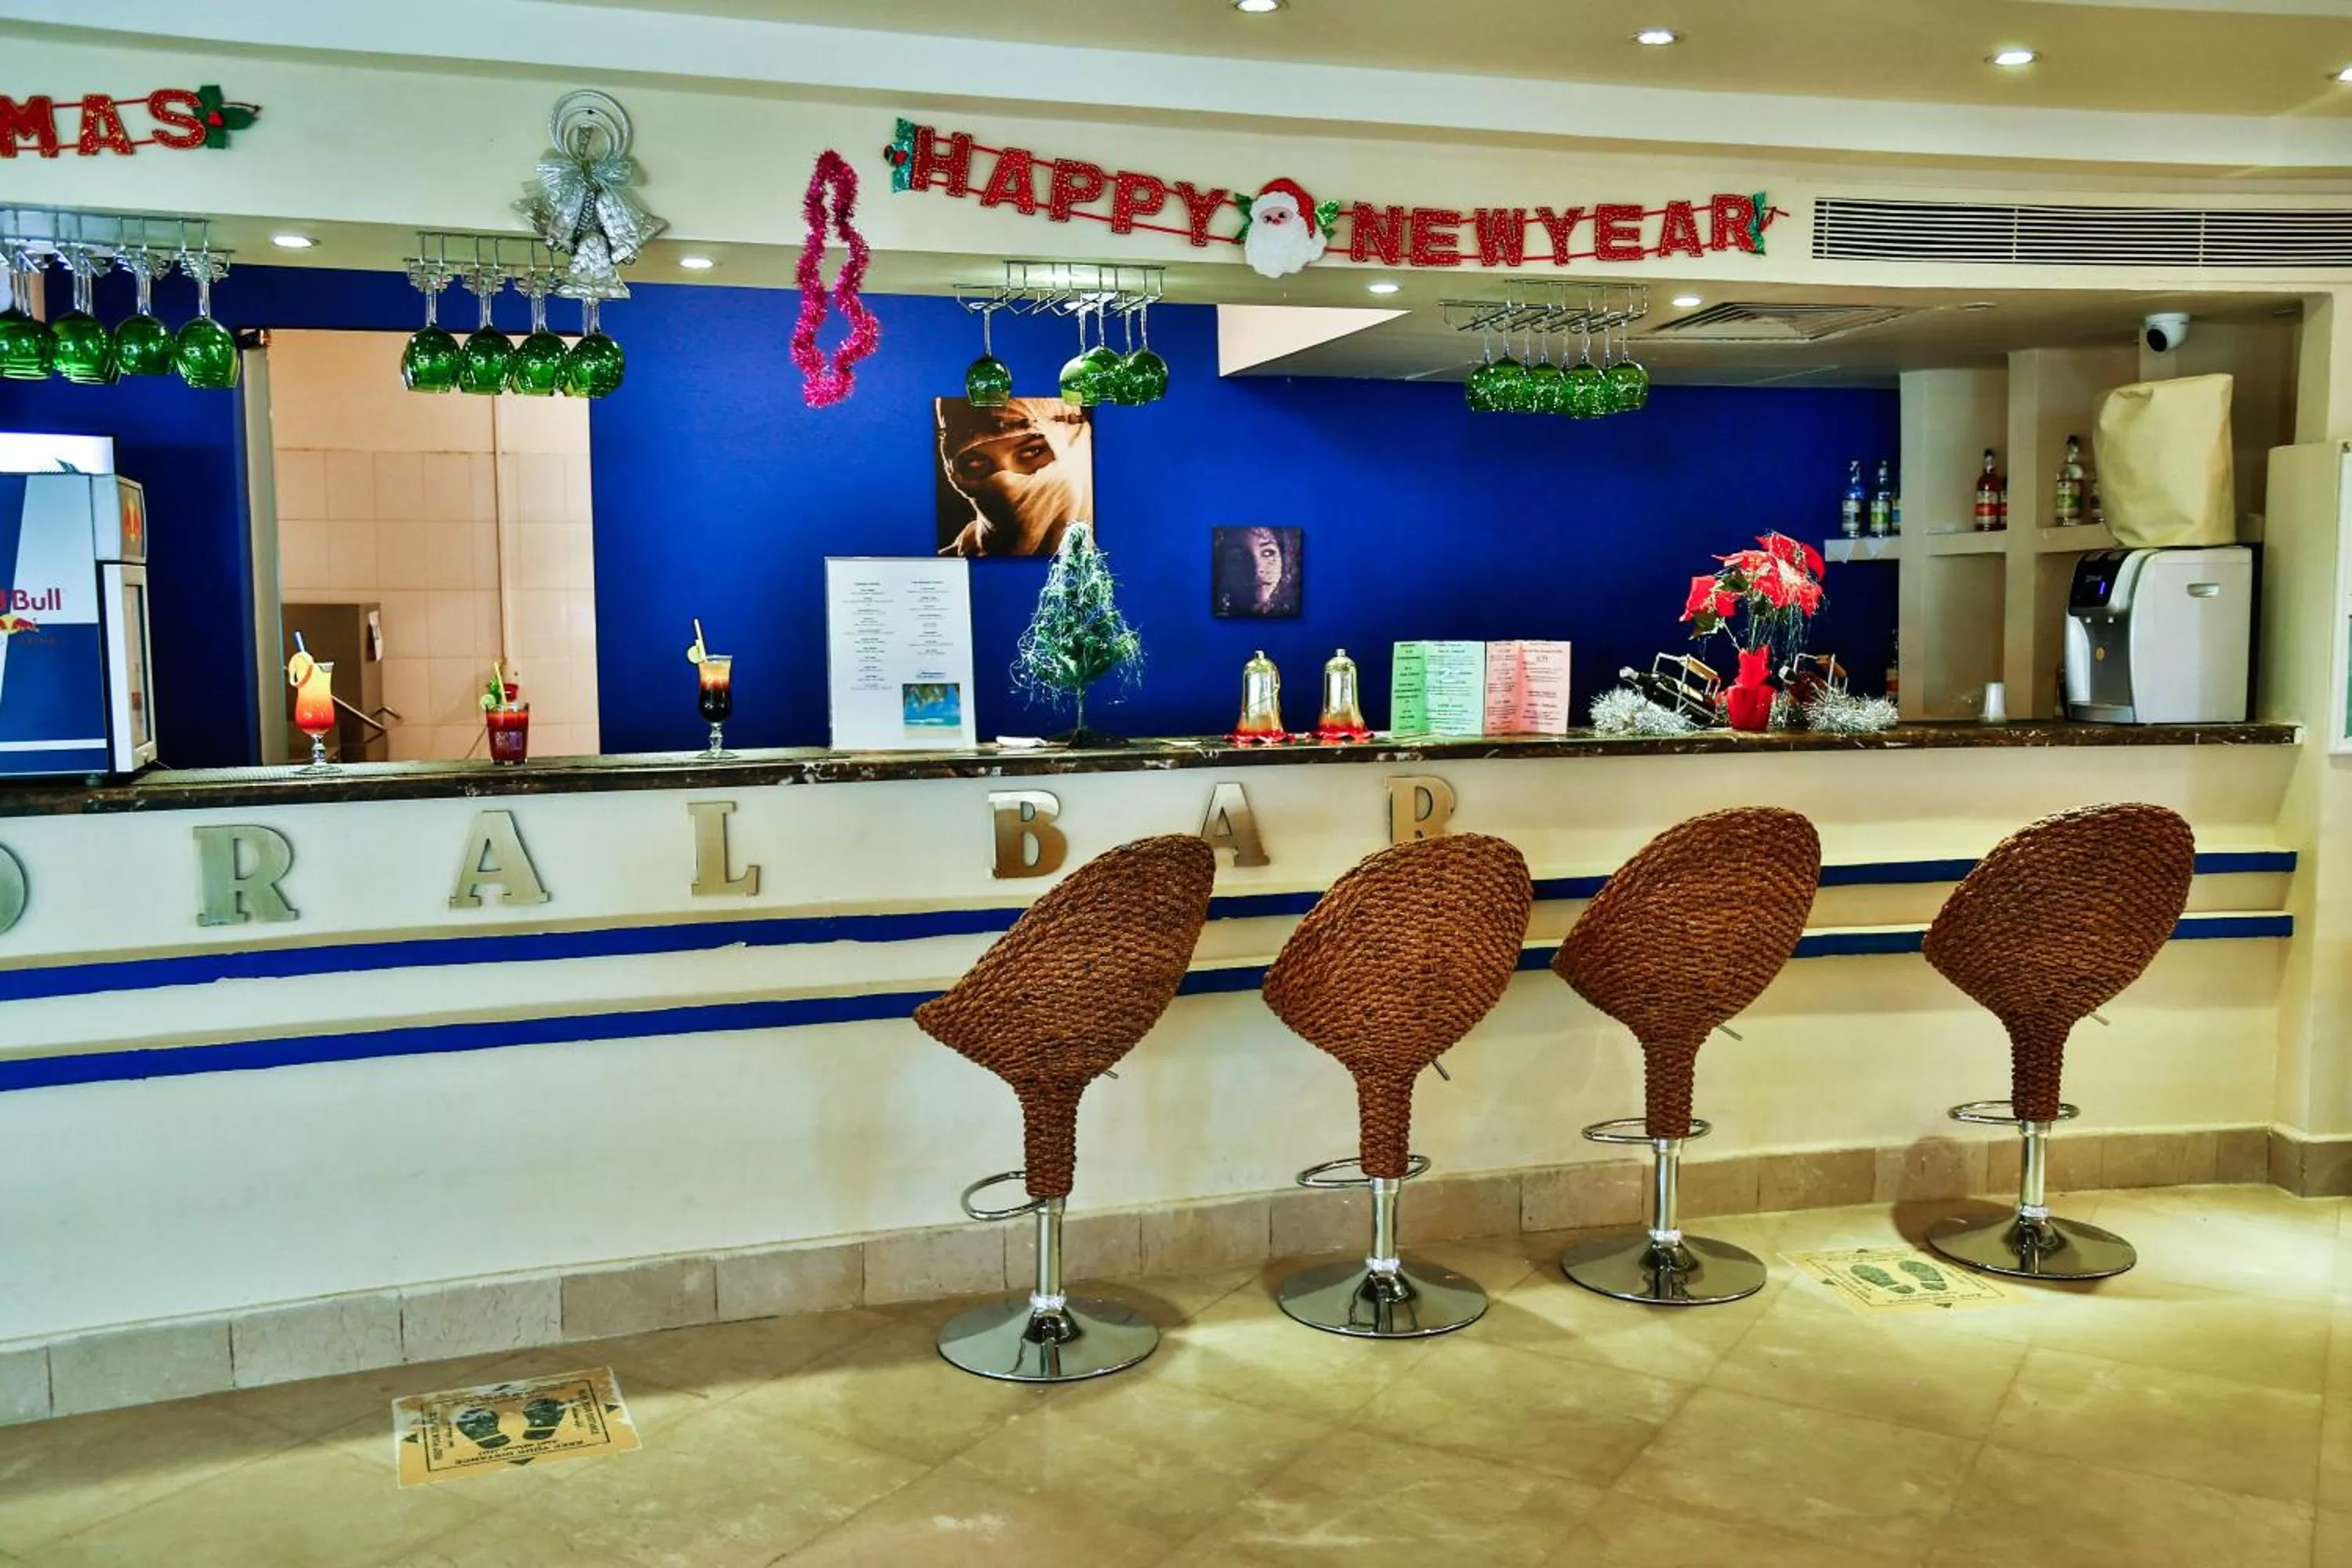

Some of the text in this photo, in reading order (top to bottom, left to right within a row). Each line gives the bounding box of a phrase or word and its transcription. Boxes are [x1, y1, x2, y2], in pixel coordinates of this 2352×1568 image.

[910, 125, 1227, 247] HAPPY
[12, 588, 62, 611] Bull
[0, 775, 1456, 938] RAL BAR
